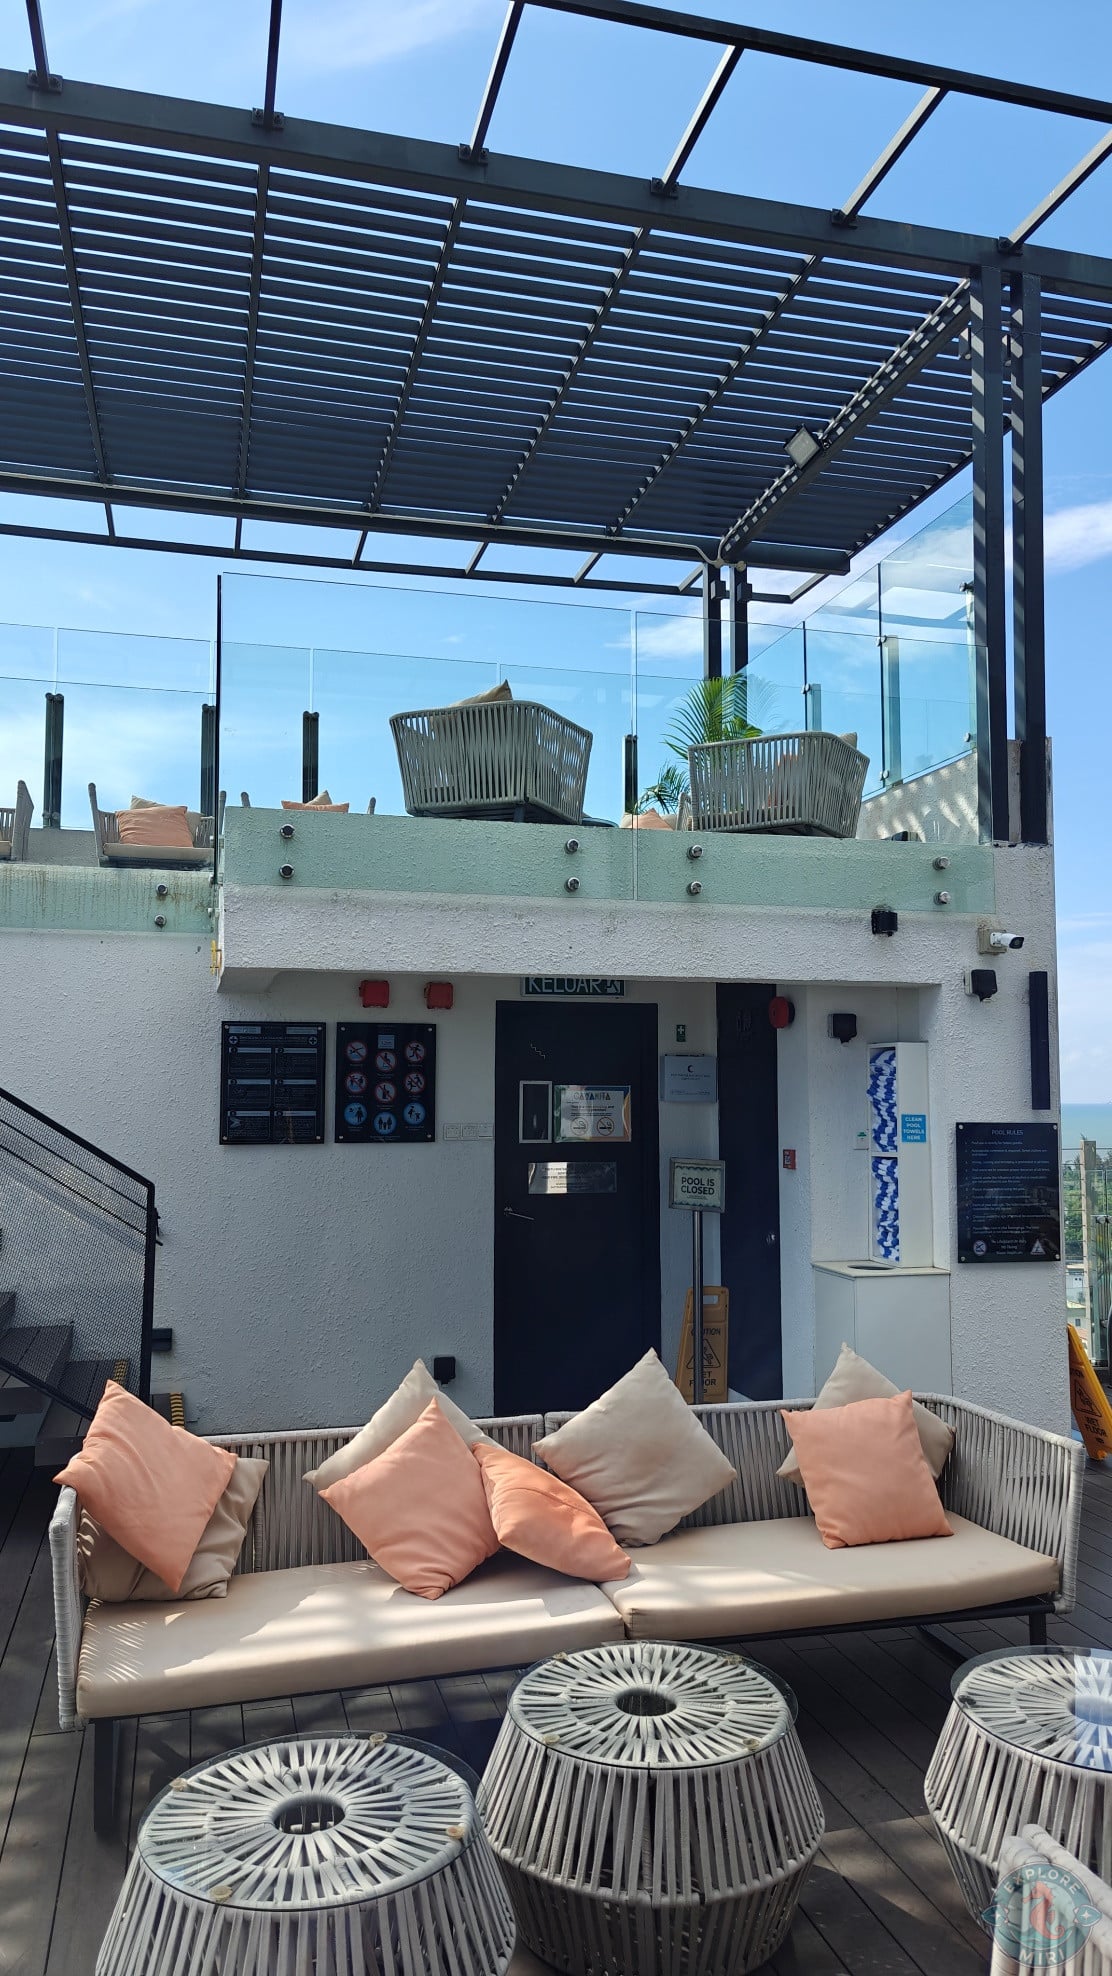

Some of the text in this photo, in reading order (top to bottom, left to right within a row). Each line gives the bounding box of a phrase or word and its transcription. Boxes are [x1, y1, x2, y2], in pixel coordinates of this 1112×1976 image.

[528, 977, 602, 993] KELUAR
[681, 1177, 715, 1187] POOL IS
[680, 1185, 715, 1195] CLOSED
[689, 1379, 716, 1387] FOR
